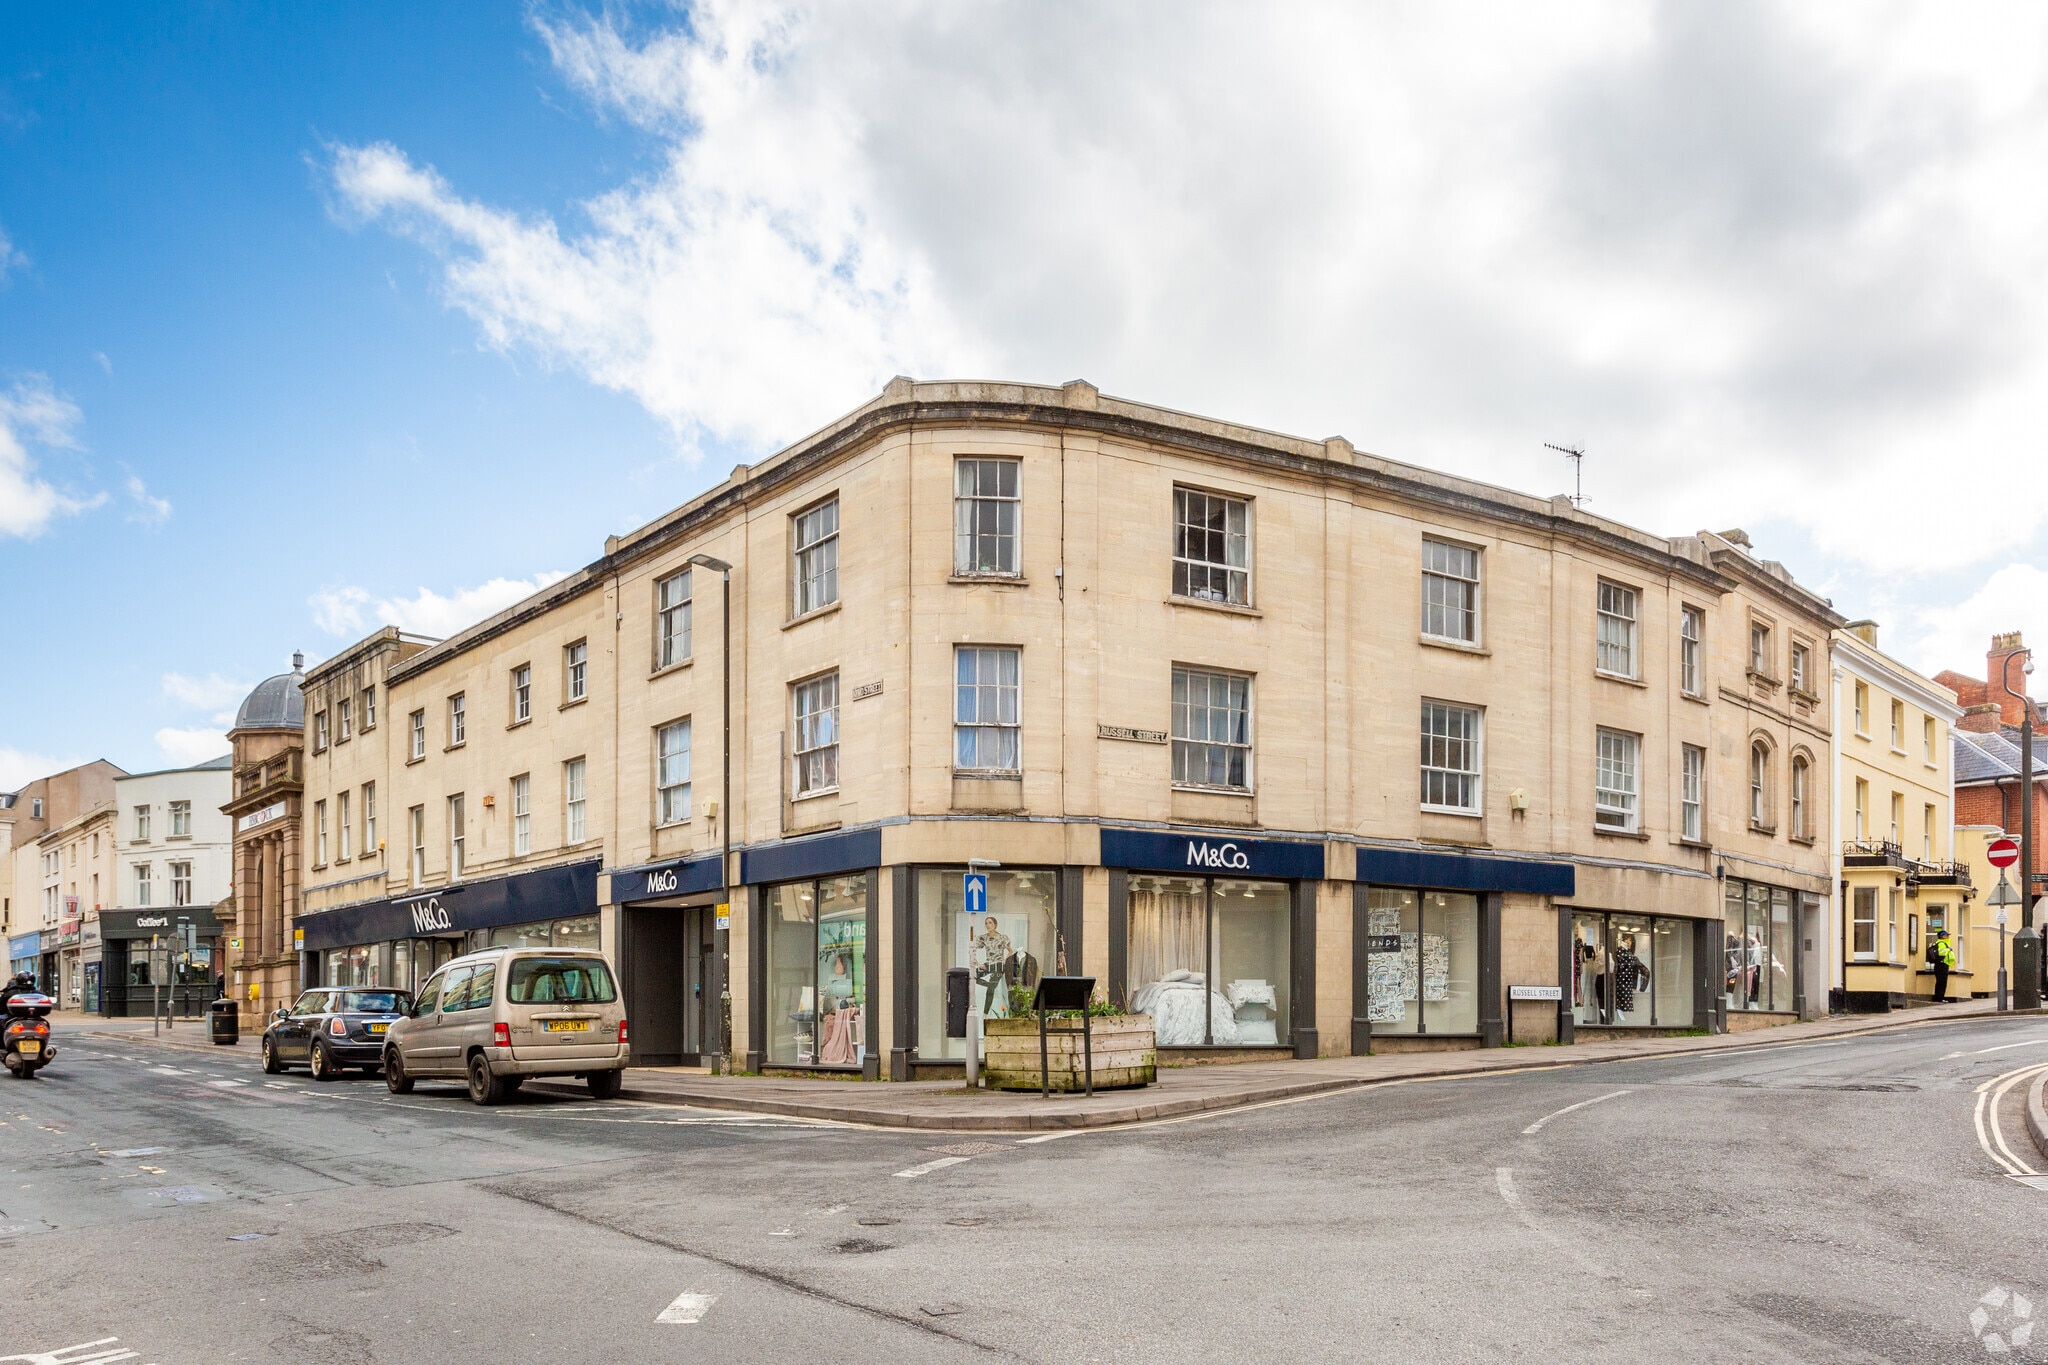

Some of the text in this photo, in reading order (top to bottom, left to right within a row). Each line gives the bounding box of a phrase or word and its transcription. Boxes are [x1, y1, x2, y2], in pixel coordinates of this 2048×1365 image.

[1100, 726, 1166, 741] RUSSELL STREET
[1187, 841, 1250, 869] M&Co.
[647, 869, 677, 893] M&Co
[411, 898, 451, 933] M&Co.
[1512, 989, 1559, 997] RUSSELL STREET
[549, 1021, 586, 1031] WP06 UWT
